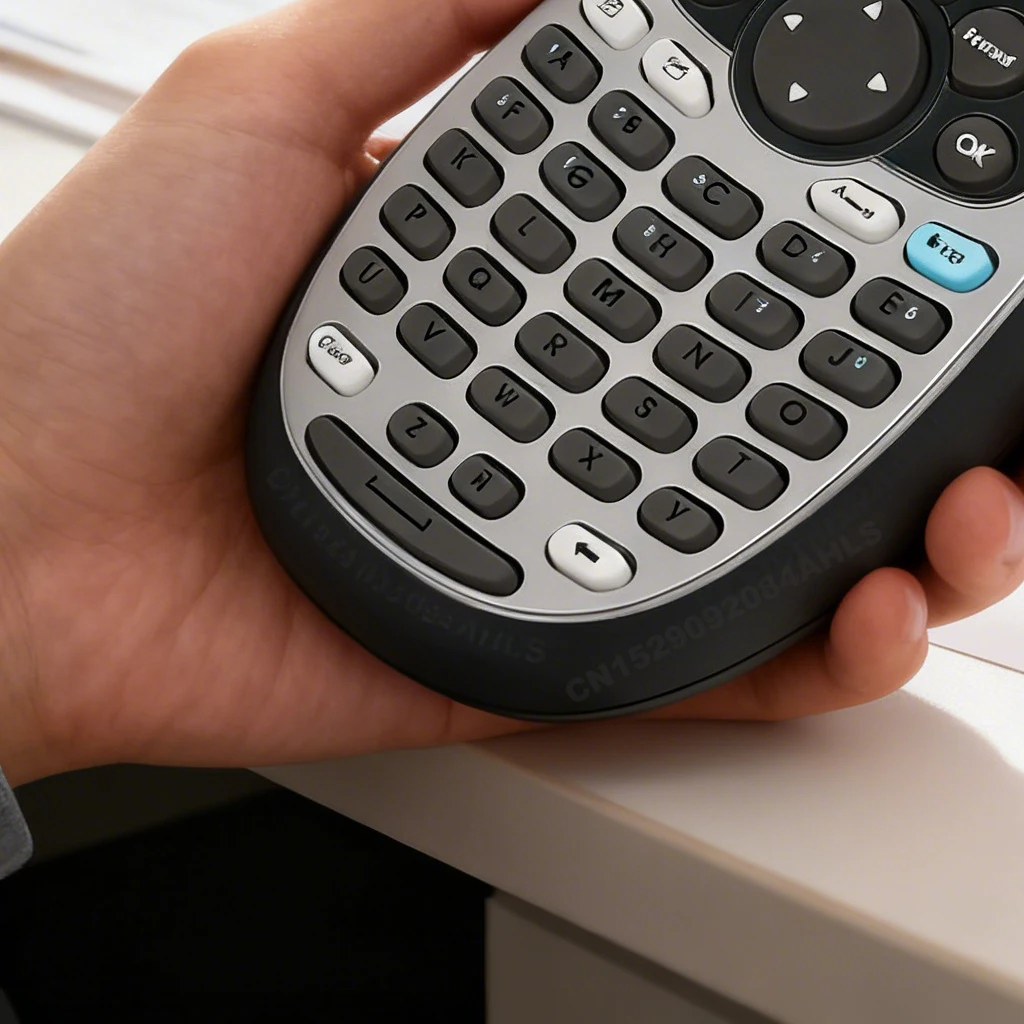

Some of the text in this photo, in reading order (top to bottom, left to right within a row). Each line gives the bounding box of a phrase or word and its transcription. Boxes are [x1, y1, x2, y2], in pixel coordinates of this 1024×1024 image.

[501, 100, 525, 120] F
[450, 147, 477, 170] K
[955, 132, 996, 169] OK
[702, 182, 731, 206] C
[404, 203, 428, 222] P
[517, 215, 537, 237] L
[781, 233, 808, 258] D
[358, 261, 385, 284] U
[591, 278, 626, 307] M
[424, 320, 447, 342] V
[543, 332, 568, 357] R
[682, 341, 714, 370] N
[828, 347, 854, 366] J
[494, 382, 520, 408] W
[634, 396, 659, 419] S
[780, 400, 808, 426] O
[405, 416, 428, 439] Z
[578, 444, 604, 472] X
[727, 451, 753, 475] T
[664, 500, 691, 522] Y
